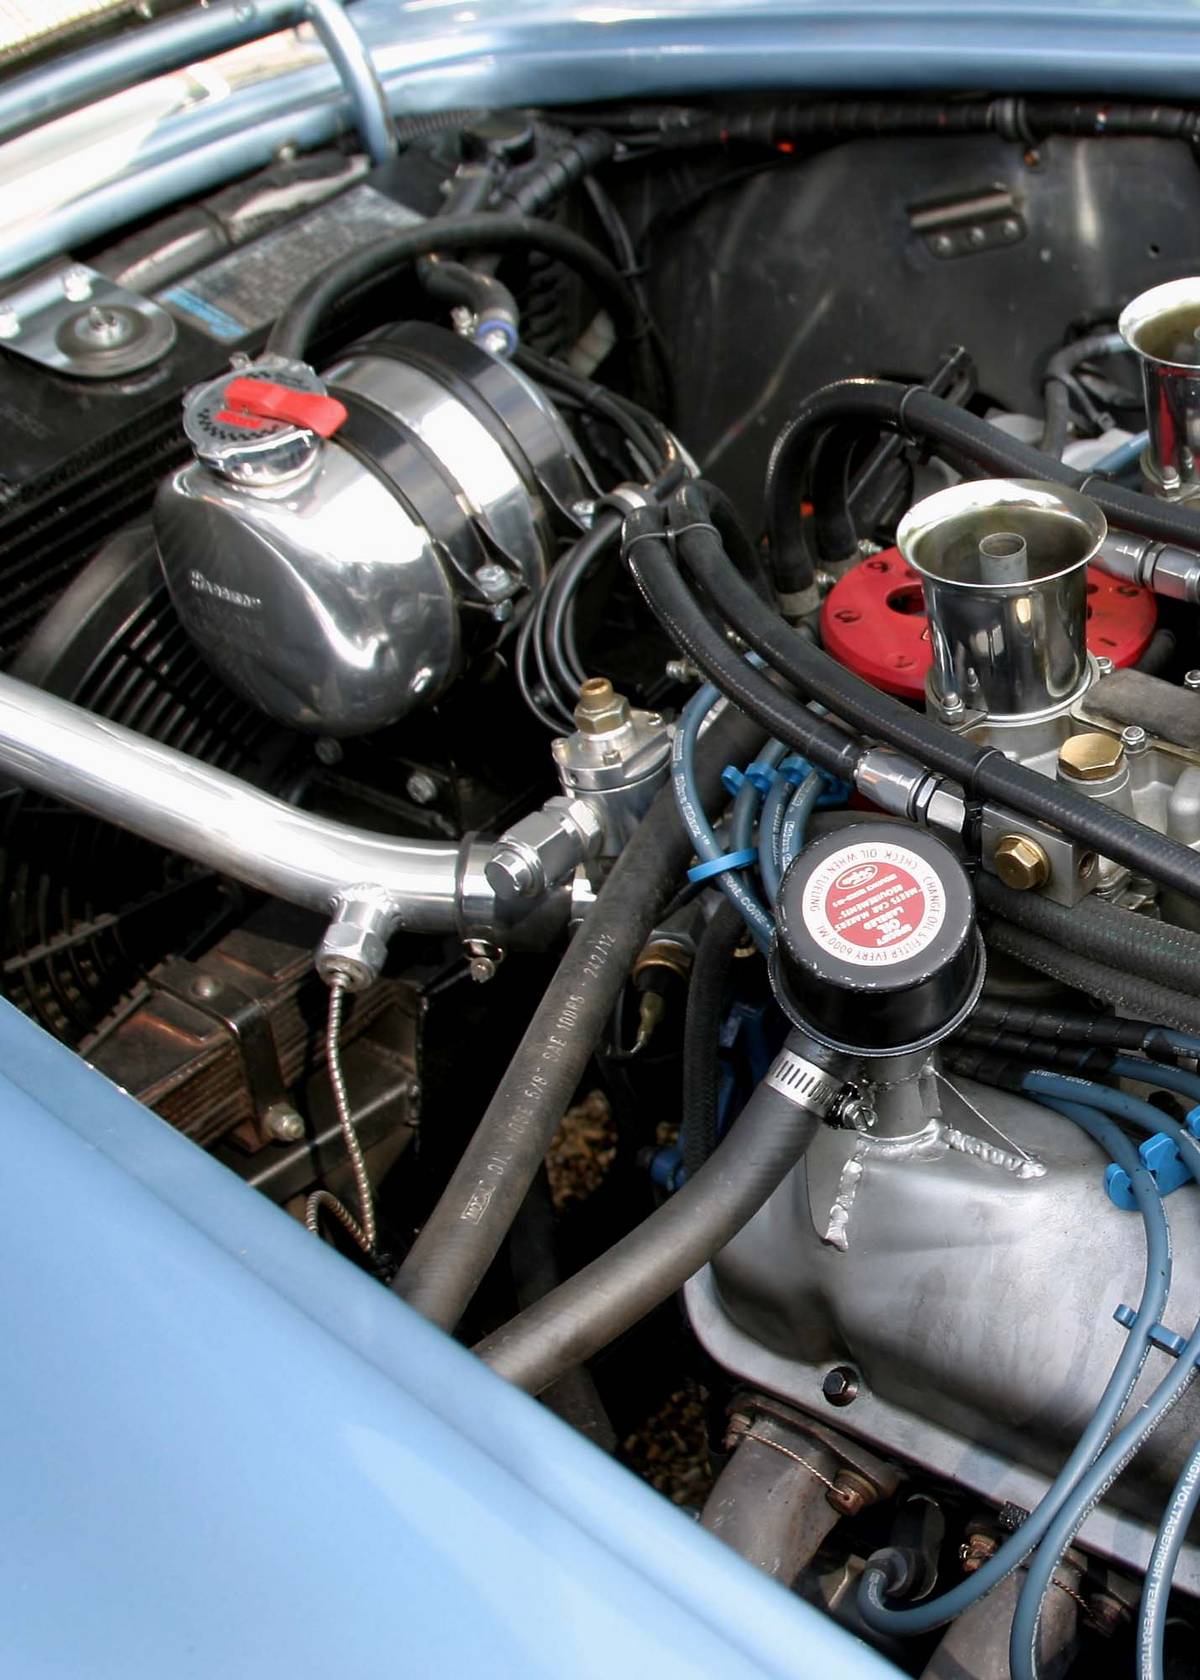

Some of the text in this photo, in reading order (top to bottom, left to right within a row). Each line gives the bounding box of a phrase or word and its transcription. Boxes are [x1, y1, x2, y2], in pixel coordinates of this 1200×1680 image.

[827, 852, 856, 874] WHEN
[860, 848, 878, 859] OIL
[884, 850, 918, 870] CHECK
[809, 875, 828, 912] FUELING
[922, 875, 941, 914] CHANGE
[828, 937, 853, 955] 6000
[855, 951, 888, 960] EVERY
[542, 1035, 568, 1063] SAE
